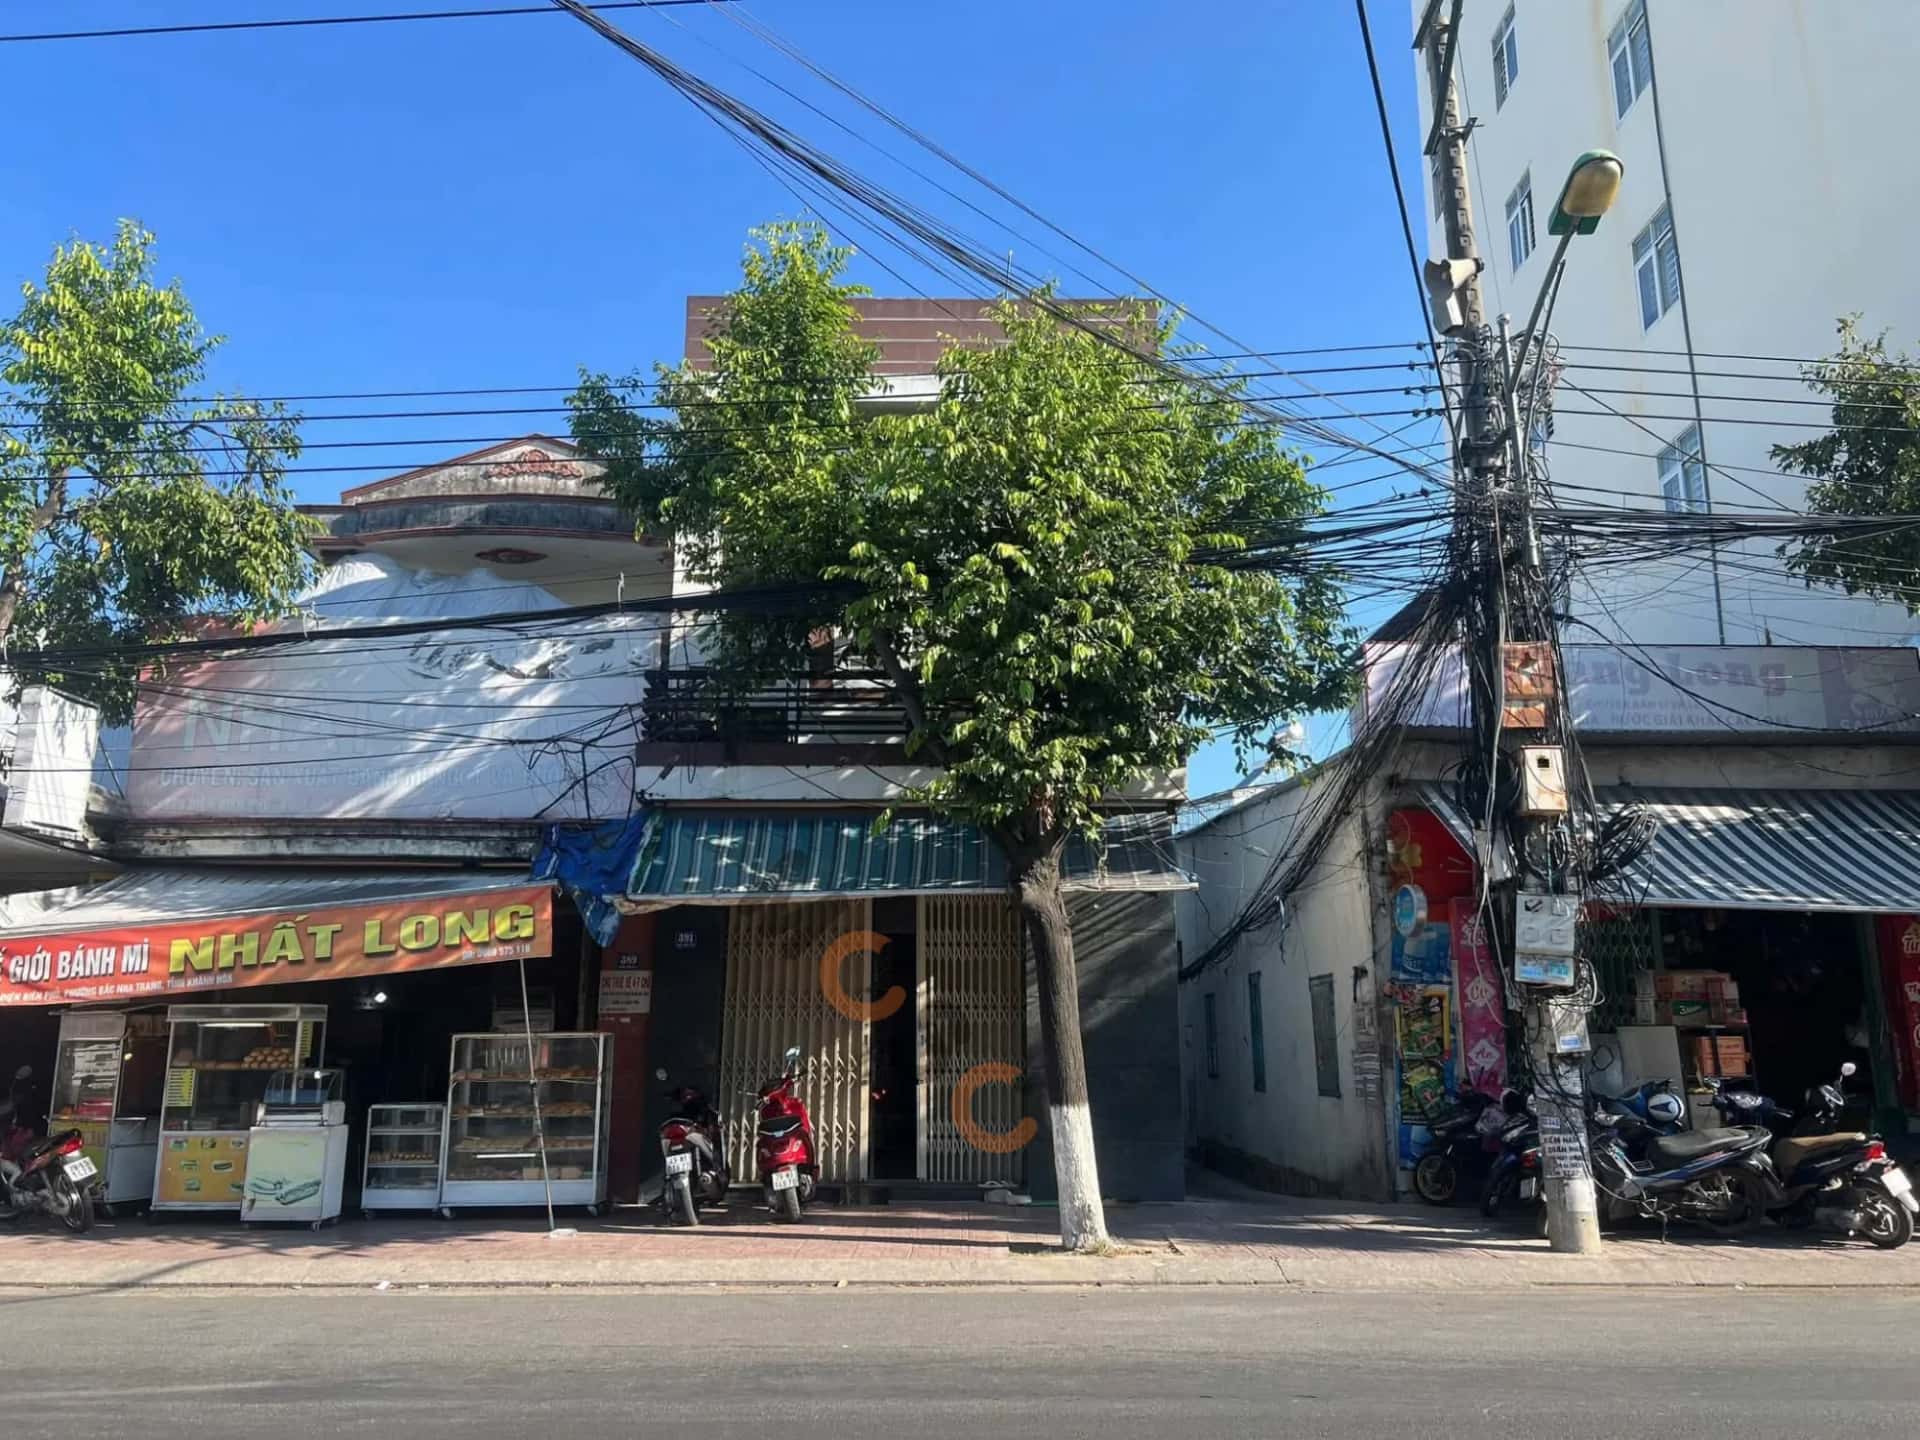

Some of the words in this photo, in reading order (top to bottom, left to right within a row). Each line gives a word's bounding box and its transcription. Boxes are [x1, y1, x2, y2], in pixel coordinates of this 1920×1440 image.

[9, 944, 51, 984] GIỚI
[57, 943, 116, 981] BÁNH
[168, 914, 342, 974] NHẤT
[363, 904, 535, 955] LONG
